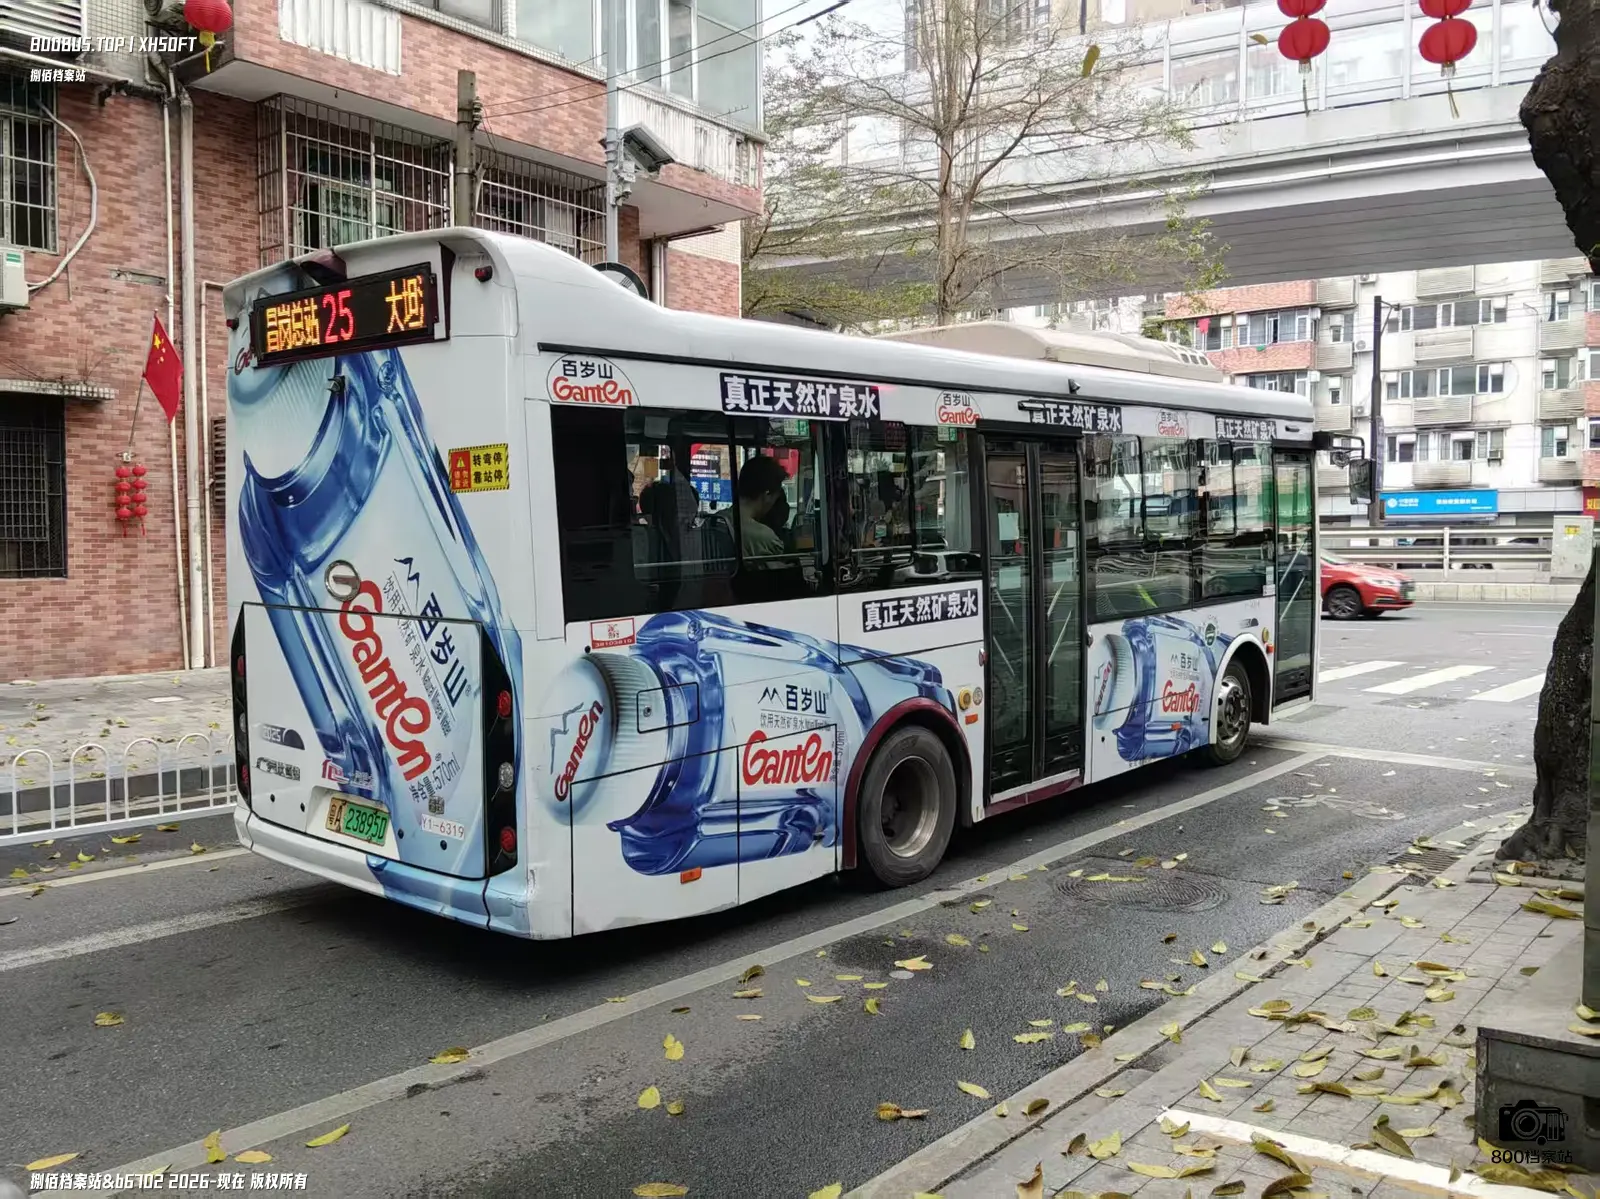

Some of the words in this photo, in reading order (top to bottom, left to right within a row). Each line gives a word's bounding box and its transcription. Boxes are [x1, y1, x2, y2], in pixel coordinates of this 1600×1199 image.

[265, 297, 321, 353] 昌岗总站
[322, 289, 355, 344] 25
[561, 359, 613, 380] 百岁山
[723, 374, 879, 420] 真正天然矿泉水
[942, 392, 971, 407] 百岁山
[1031, 403, 1121, 432] 真正天然矿泉水
[1216, 417, 1277, 441] 真正天然矿泉水
[472, 451, 503, 467] 转弯停
[473, 469, 503, 484] 靠站停
[864, 593, 978, 631] 真正天然矿泉水
[382, 575, 427, 677] 饮用天然矿泉水
[417, 592, 468, 708] 百岁山
[786, 684, 827, 715] 百岁山
[760, 712, 805, 731] 饮用天然矿泉水
[421, 818, 465, 839] Y1-6319
